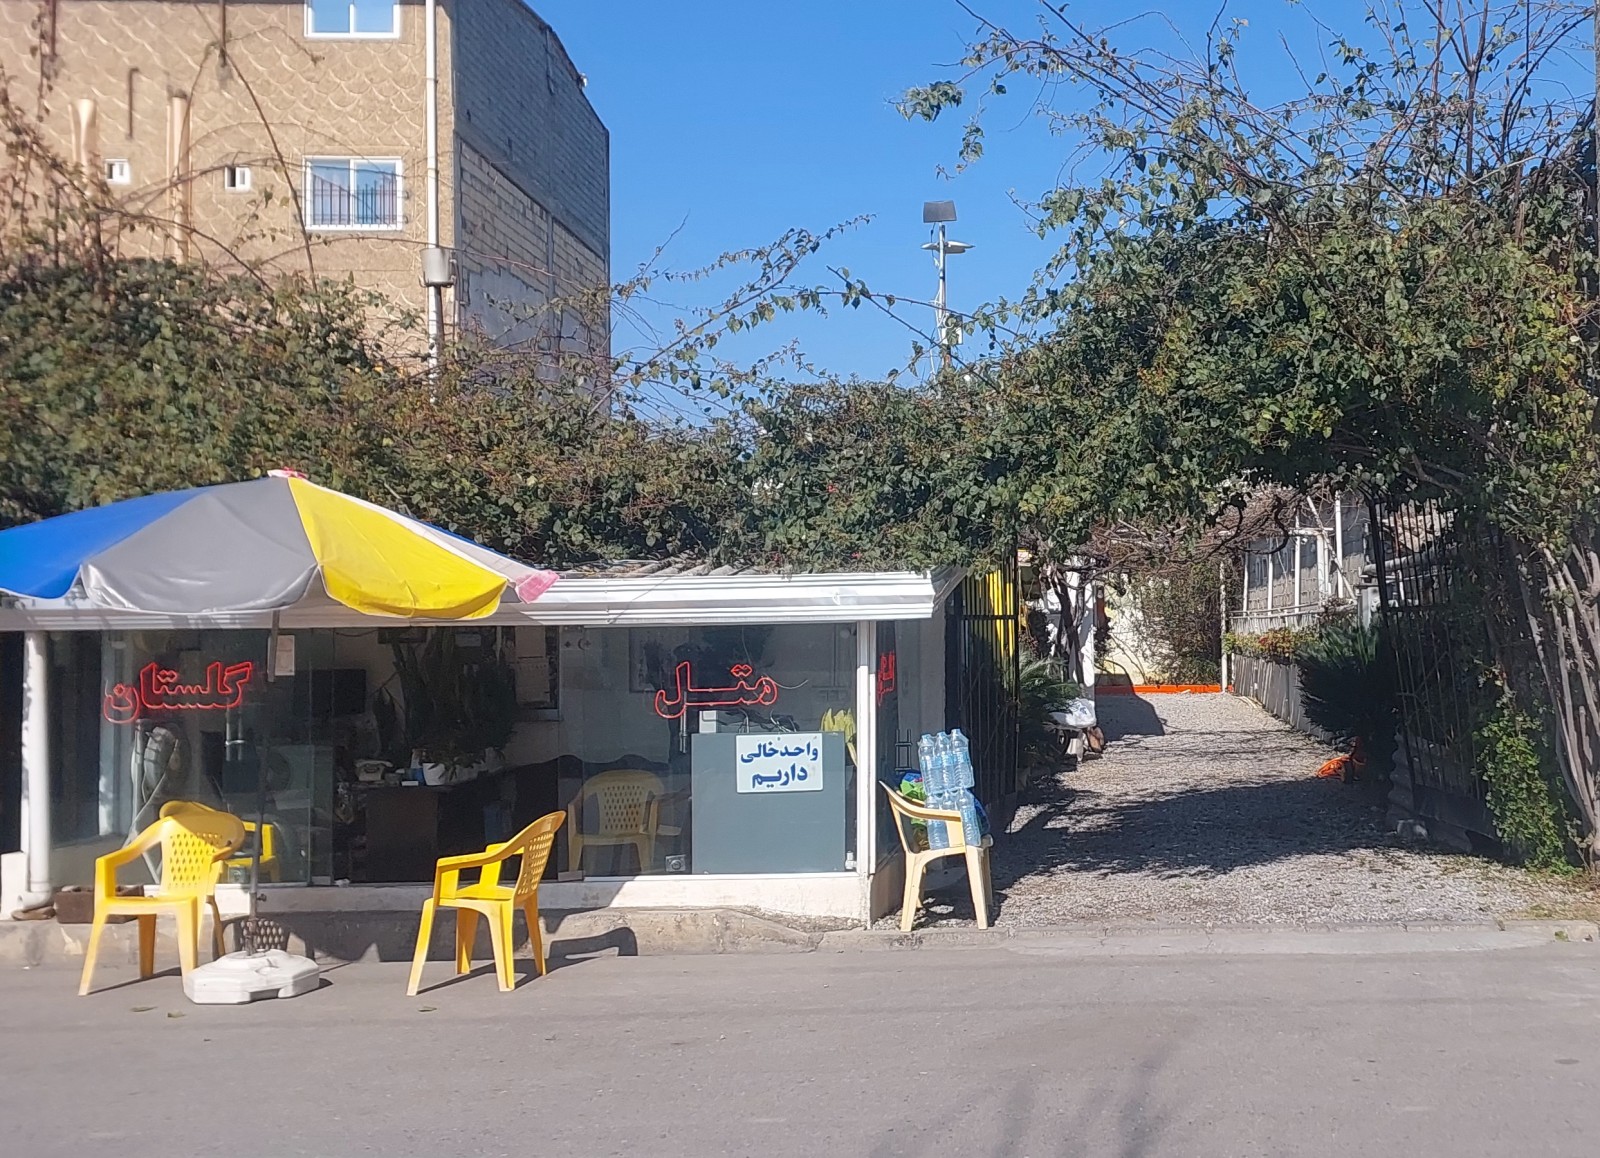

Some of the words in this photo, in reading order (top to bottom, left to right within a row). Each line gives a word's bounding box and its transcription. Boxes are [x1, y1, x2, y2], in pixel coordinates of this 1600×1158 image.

[103, 661, 253, 724] گلستان
[654, 660, 778, 719] متل
[740, 741, 778, 764] خالی
[779, 742, 817, 761] واحد
[752, 764, 807, 789] داریم
